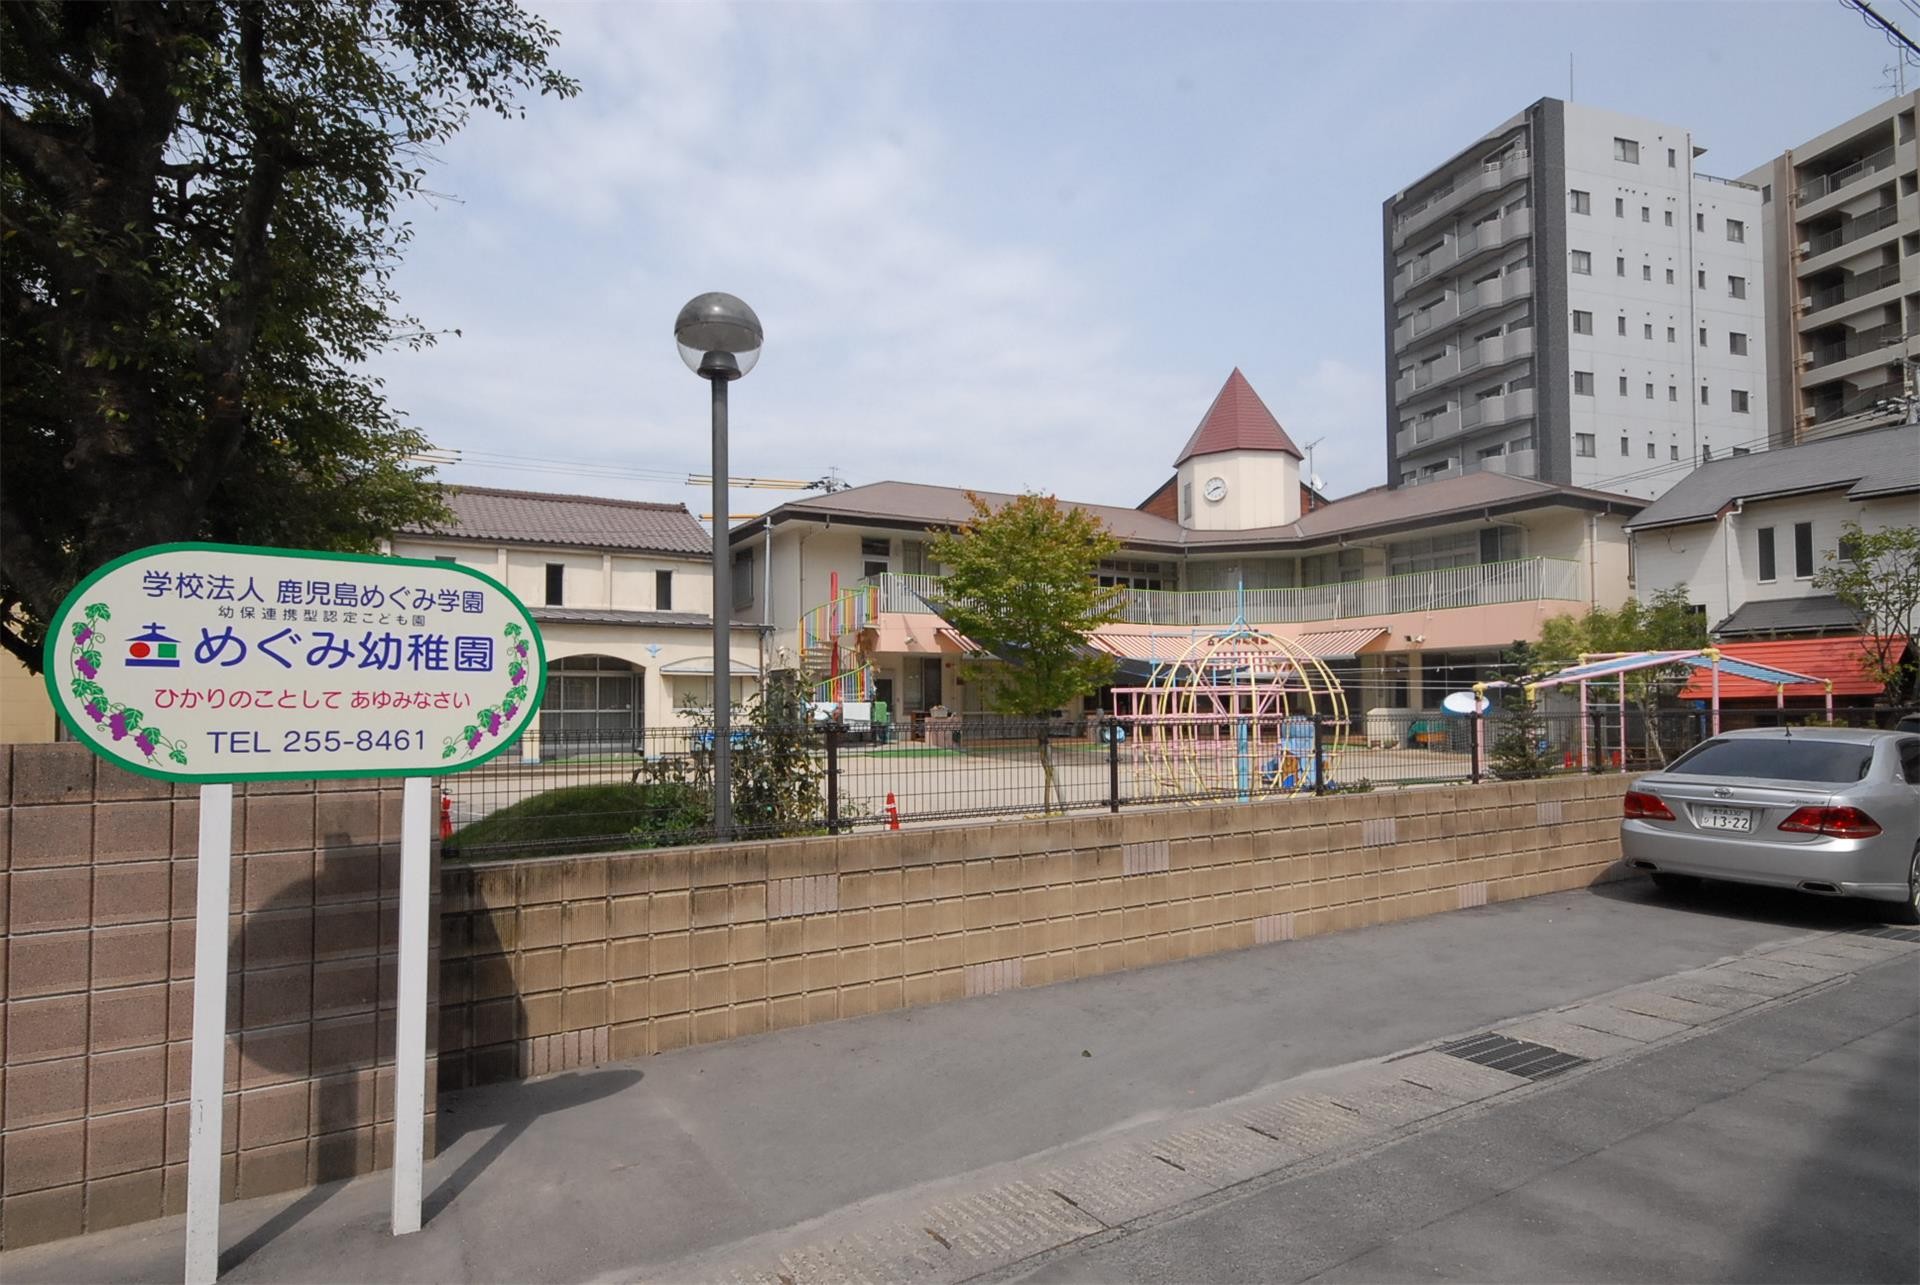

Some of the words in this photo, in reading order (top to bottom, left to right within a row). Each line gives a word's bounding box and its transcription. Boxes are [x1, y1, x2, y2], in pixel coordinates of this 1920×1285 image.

[142, 570, 265, 603] 学校法人
[277, 579, 484, 614] 鹿児島めぐみ学園
[218, 605, 426, 627] 幼保連携型認定こども園
[194, 626, 494, 672] めぐみ幼稚園
[155, 688, 342, 709] ひかりのことして
[350, 690, 470, 709] あゆみなさい
[206, 731, 271, 753] TEL
[283, 730, 424, 752] 255-8461
[1713, 815, 1749, 829] 13-22
